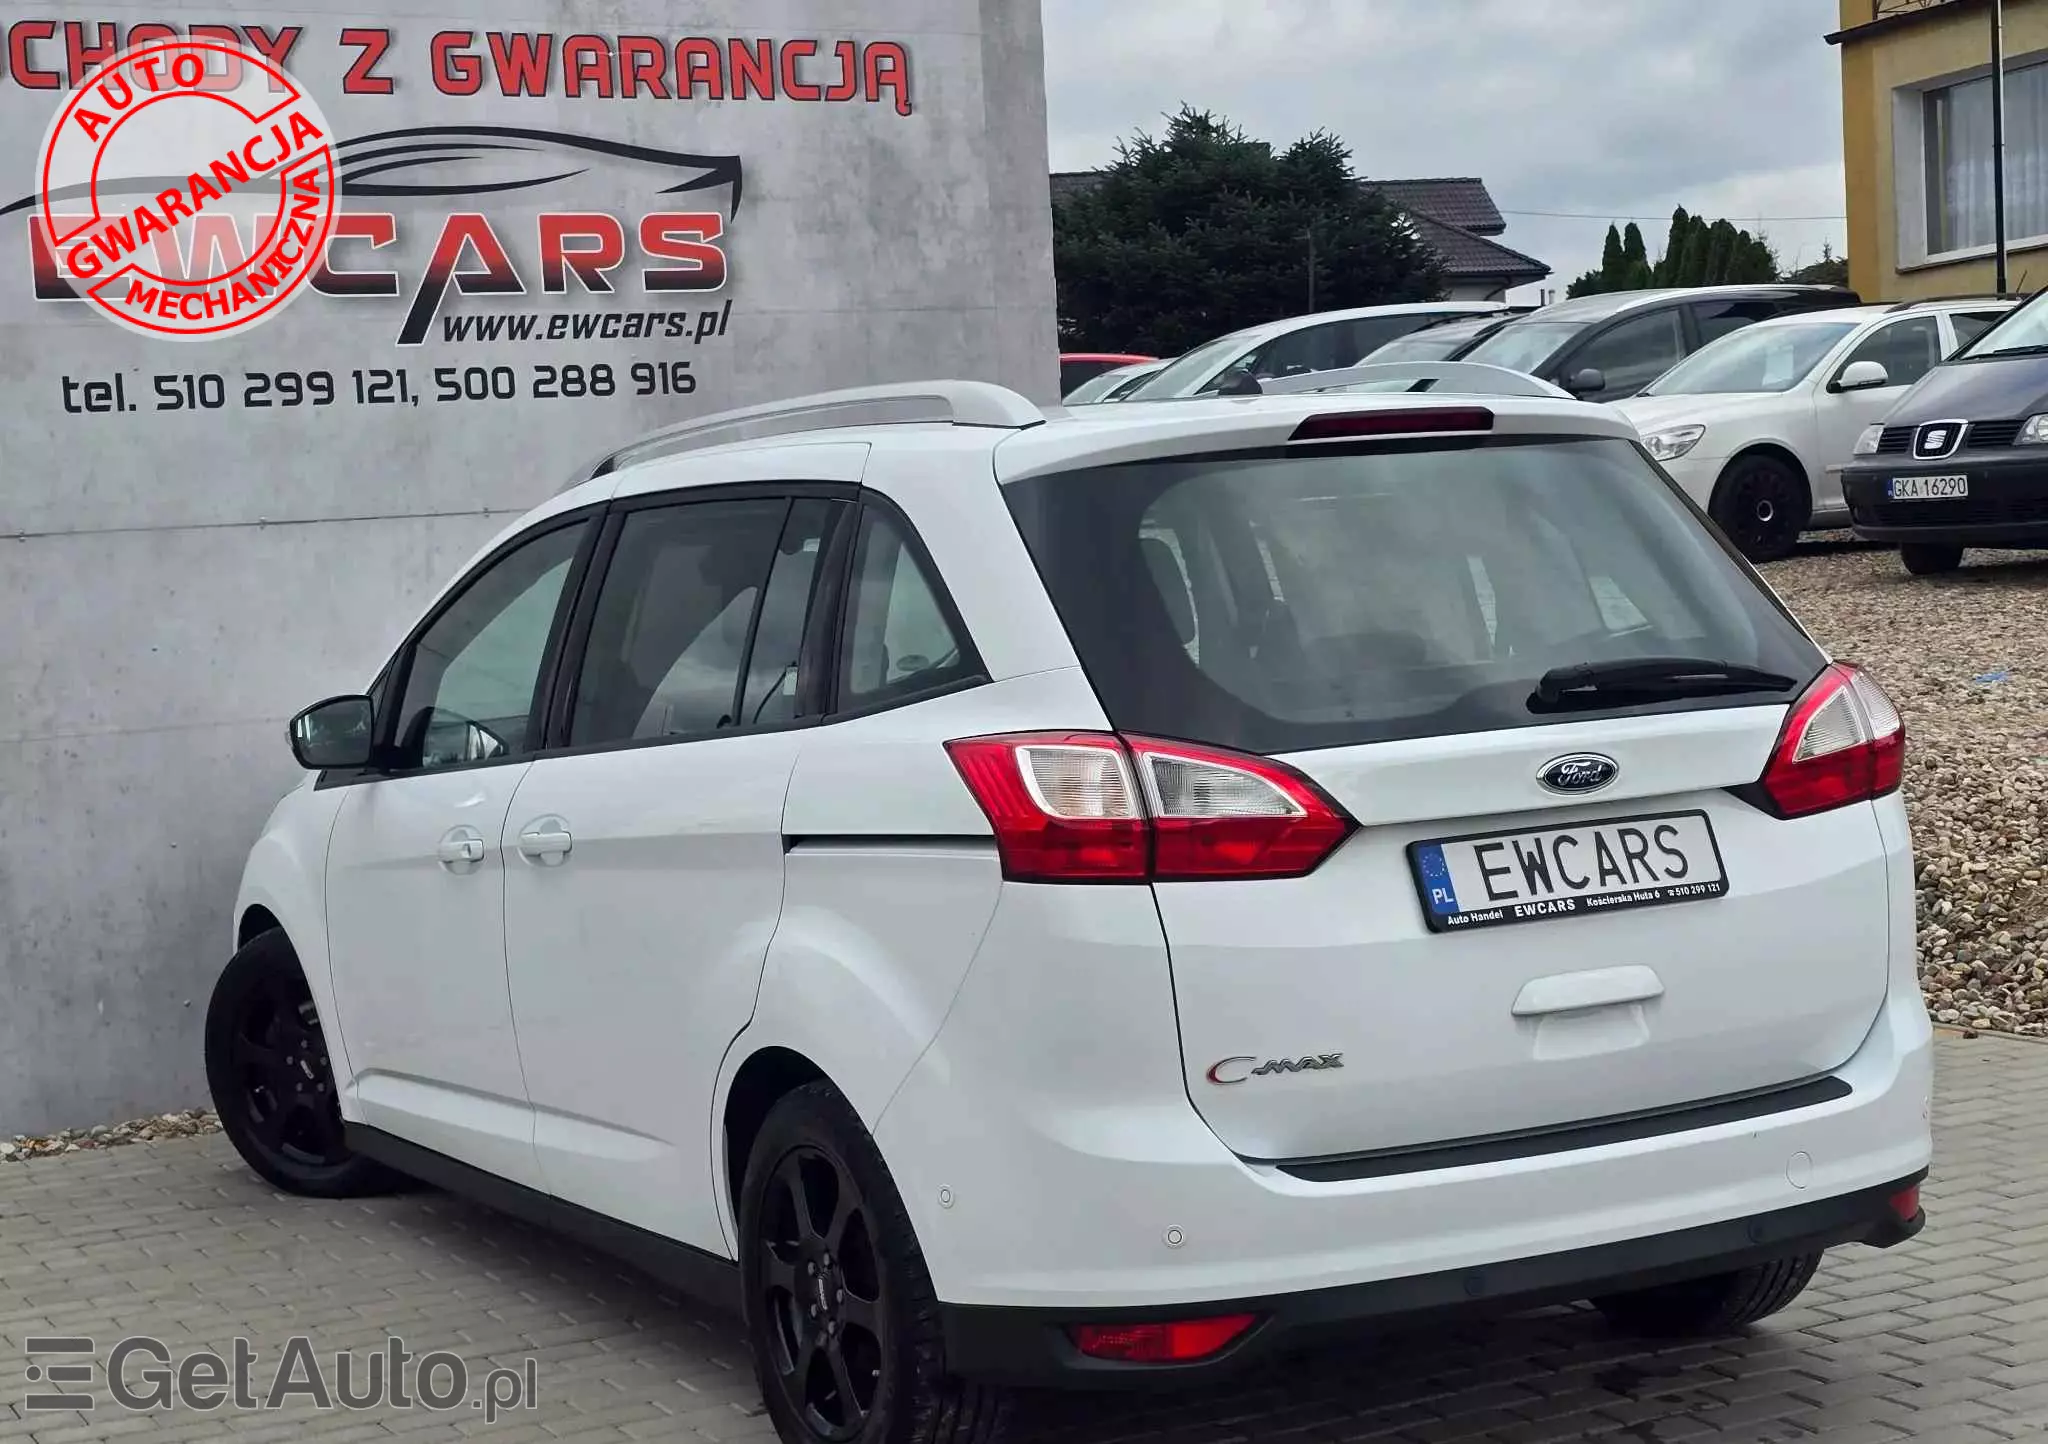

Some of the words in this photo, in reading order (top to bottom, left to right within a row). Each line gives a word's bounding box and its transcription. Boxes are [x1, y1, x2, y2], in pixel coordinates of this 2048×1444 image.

[340, 28, 395, 95] Z
[430, 31, 912, 117] GWARANCJĄ
[28, 211, 728, 346] EWCARS
[441, 300, 733, 345] www.ewcars.pl
[62, 373, 137, 413] tel.
[153, 374, 226, 411] 510
[244, 371, 335, 408] 299
[352, 368, 419, 407] 121,
[434, 366, 516, 402] 500
[532, 363, 616, 399] 288
[630, 361, 697, 396] 916
[1894, 479, 1919, 497] GKA
[1924, 477, 1967, 497] 16290
[1556, 760, 1604, 787] Ford
[1473, 824, 1690, 903] EWCARS
[1431, 888, 1455, 904] PL
[1447, 914, 1469, 926] Auto
[1514, 898, 1577, 918] EWCARS
[1654, 890, 1661, 899] 6
[1675, 885, 1690, 897] 510
[1691, 884, 1706, 895] 299
[1707, 882, 1721, 893] 121
